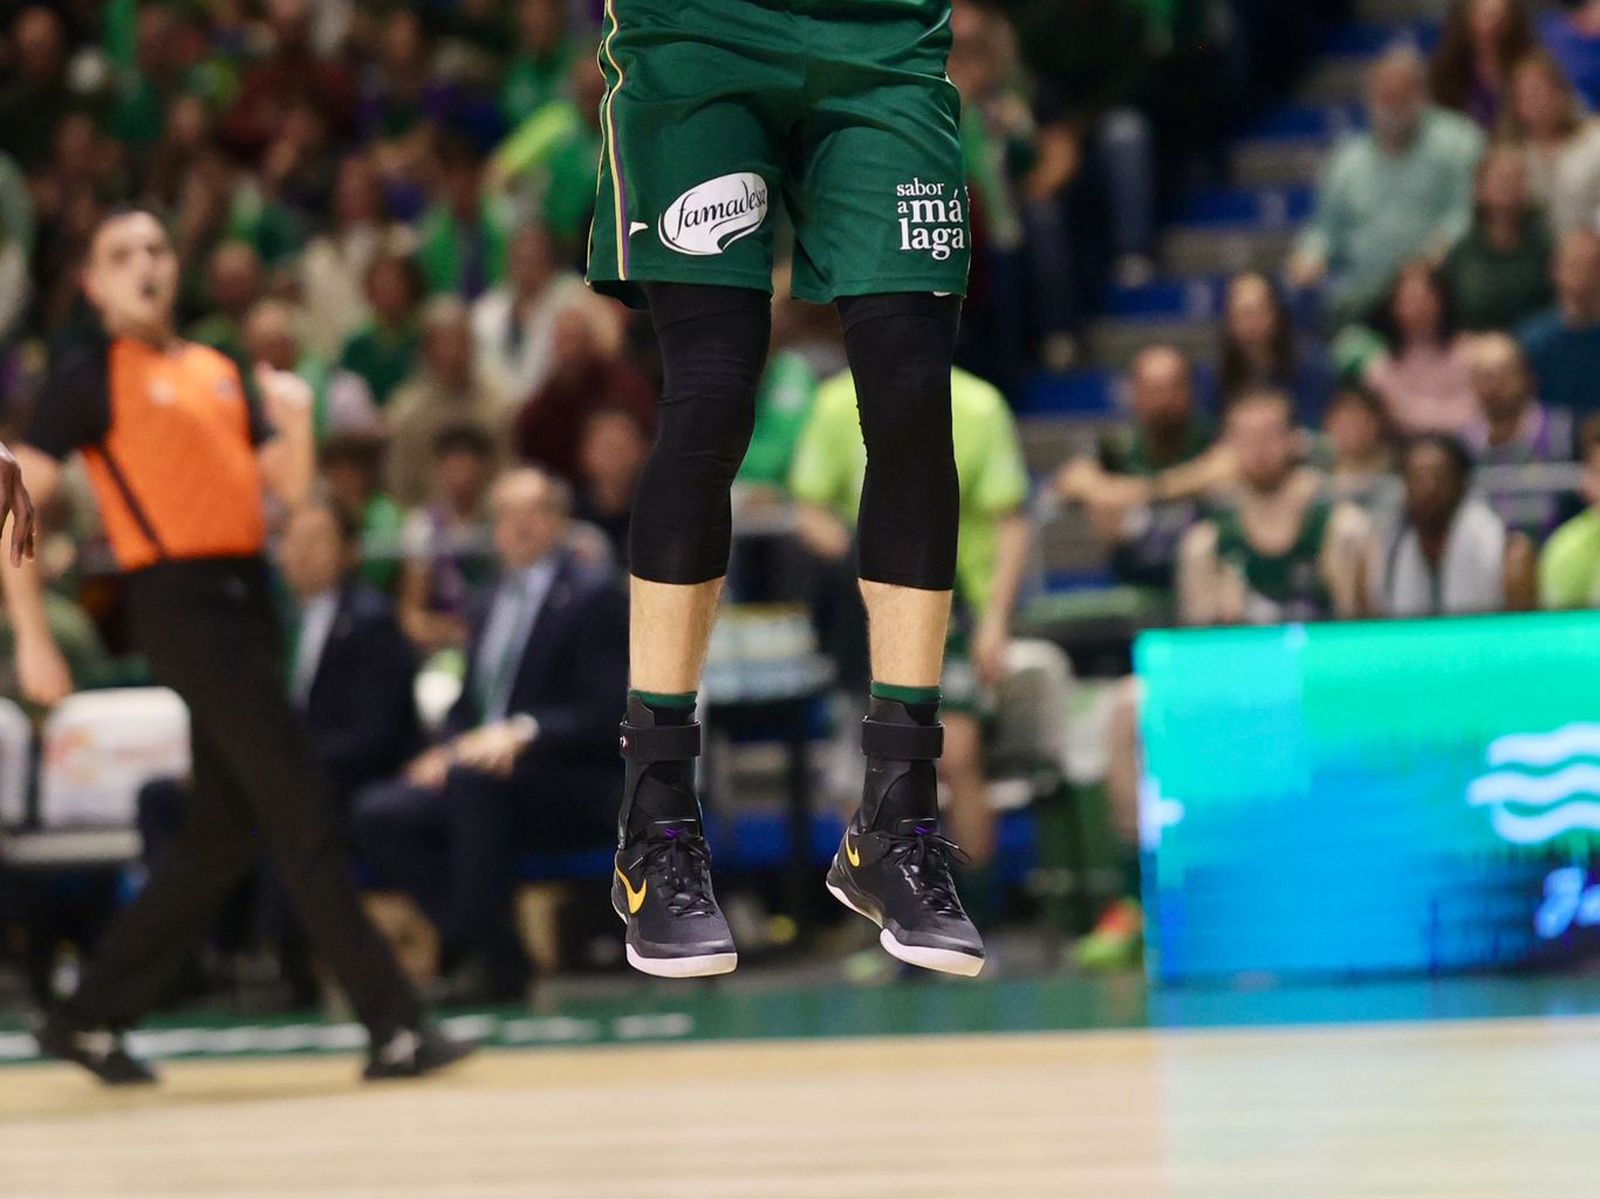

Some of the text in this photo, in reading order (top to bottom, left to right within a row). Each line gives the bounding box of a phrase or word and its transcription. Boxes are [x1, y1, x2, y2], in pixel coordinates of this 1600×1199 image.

[896, 177, 945, 196] sabor
[897, 188, 964, 223] a má
[672, 179, 767, 241] famadesa
[898, 217, 966, 261] laga
